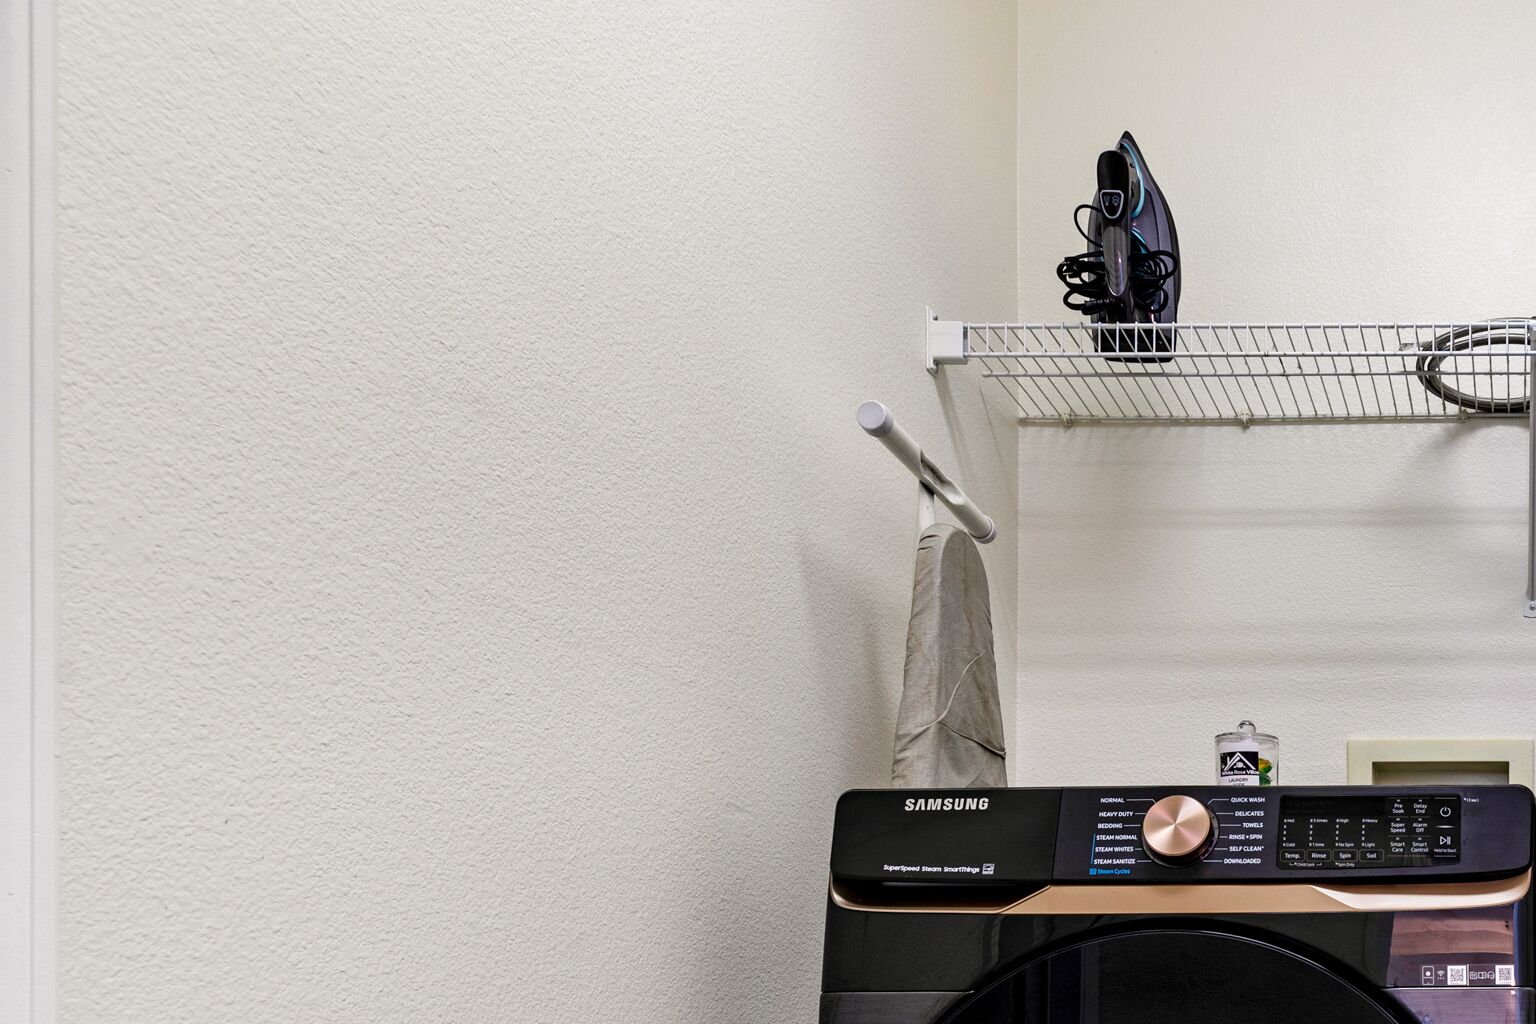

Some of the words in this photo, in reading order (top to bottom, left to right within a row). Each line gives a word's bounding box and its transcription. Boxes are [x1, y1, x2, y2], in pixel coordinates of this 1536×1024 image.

[904, 798, 990, 811] SAMSUNG
[883, 864, 920, 872] SuperSpeed
[943, 866, 980, 874] SmartThings
